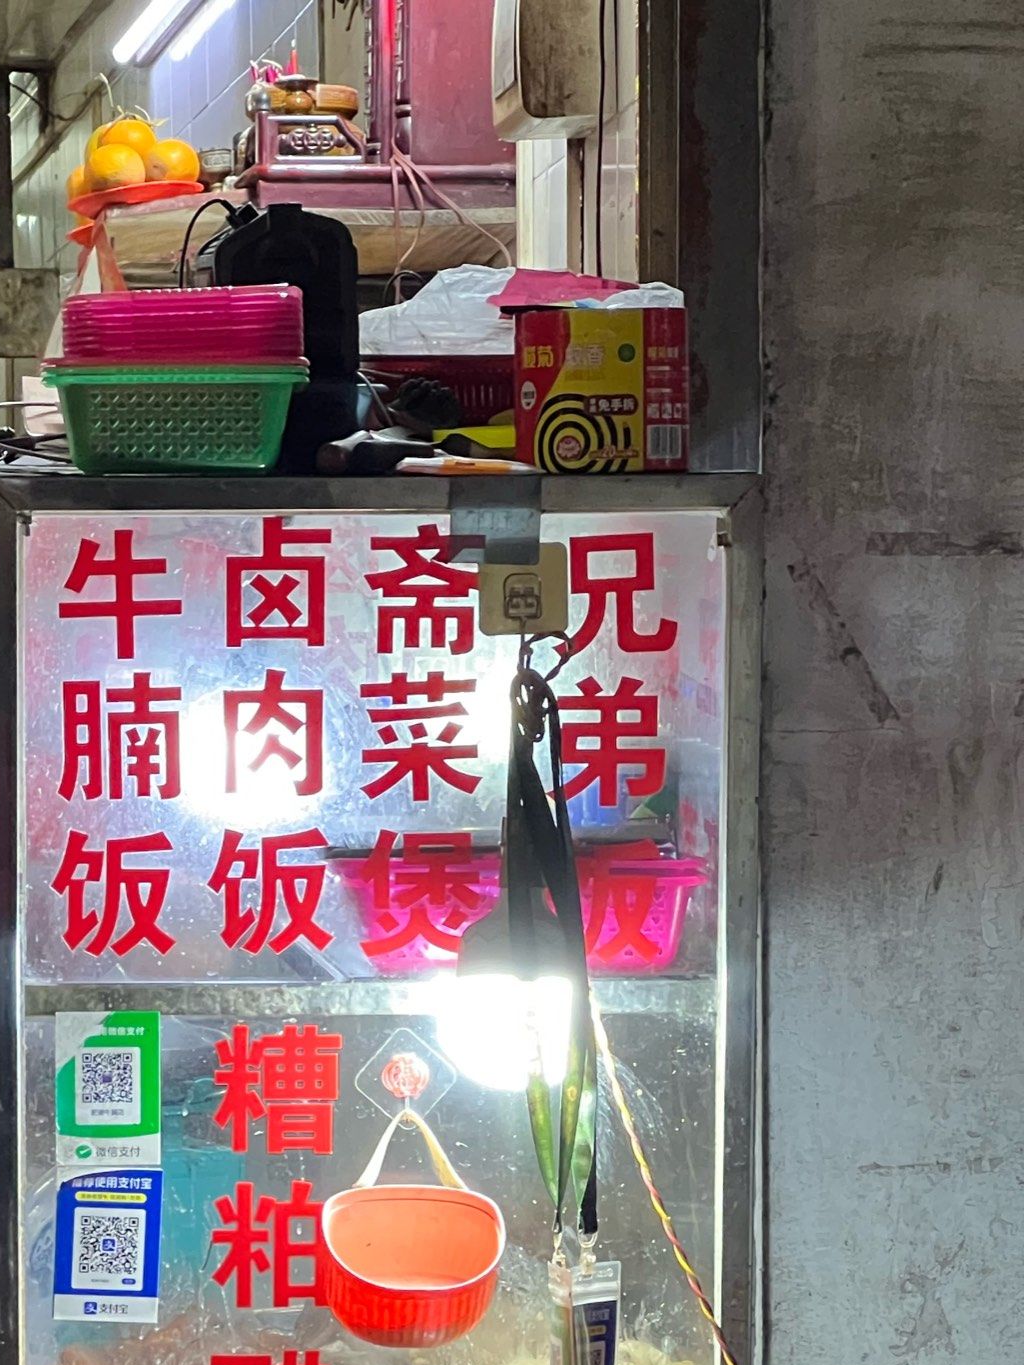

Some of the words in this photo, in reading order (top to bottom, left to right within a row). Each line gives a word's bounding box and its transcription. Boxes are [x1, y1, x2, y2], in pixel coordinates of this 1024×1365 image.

[51, 529, 182, 957] 牛腩饭
[207, 516, 335, 956] 卤肉饭
[358, 524, 486, 960] 斋菜煲
[95, 1146, 141, 1158] 微信支付
[99, 1303, 129, 1315] 支付宝
